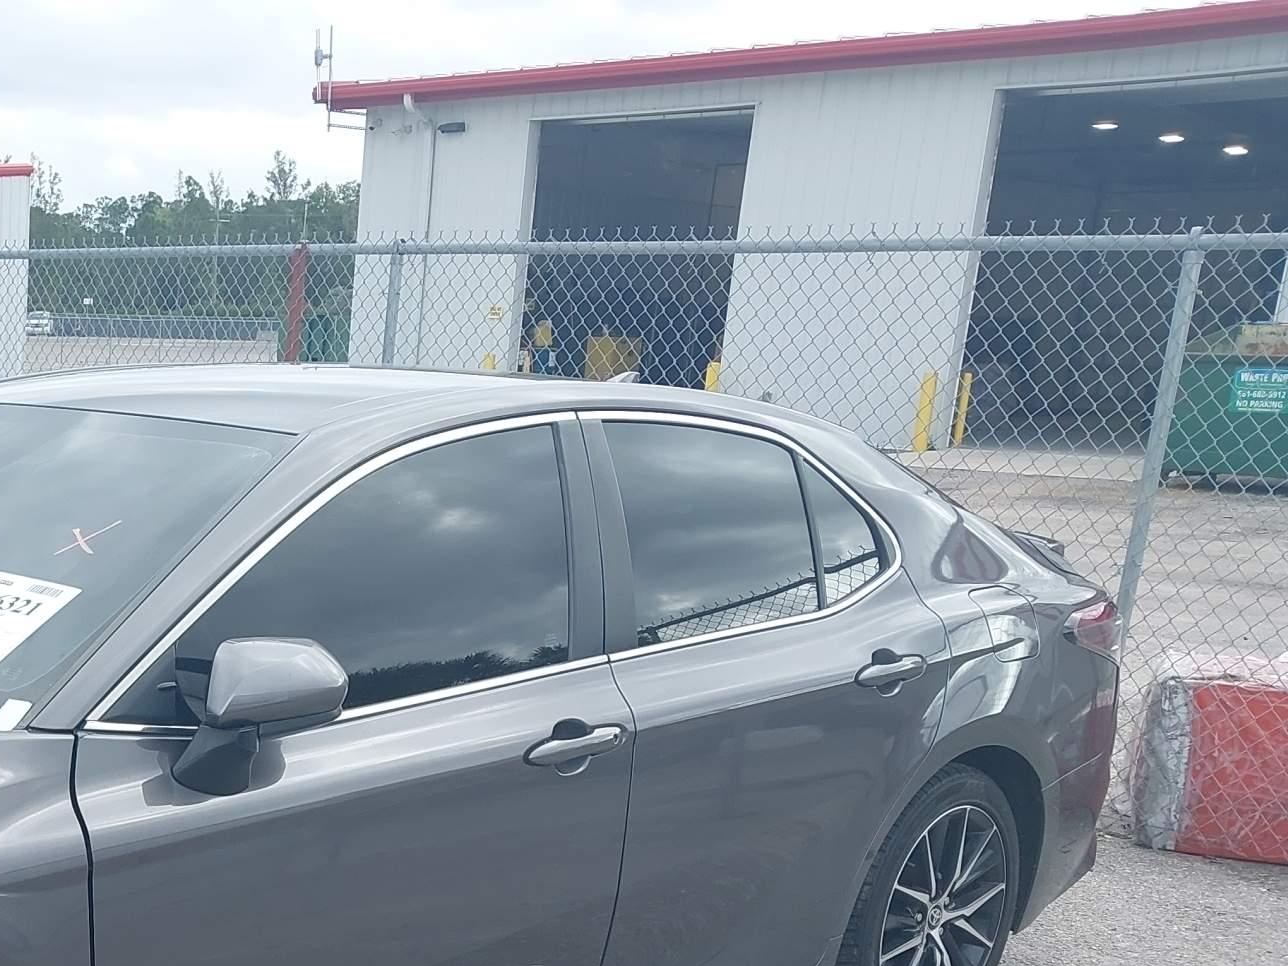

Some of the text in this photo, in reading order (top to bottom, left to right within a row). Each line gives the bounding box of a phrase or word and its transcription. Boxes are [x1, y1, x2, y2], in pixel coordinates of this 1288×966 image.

[1240, 372, 1269, 383] WASTE
[1235, 399, 1284, 409] NO PARKING
